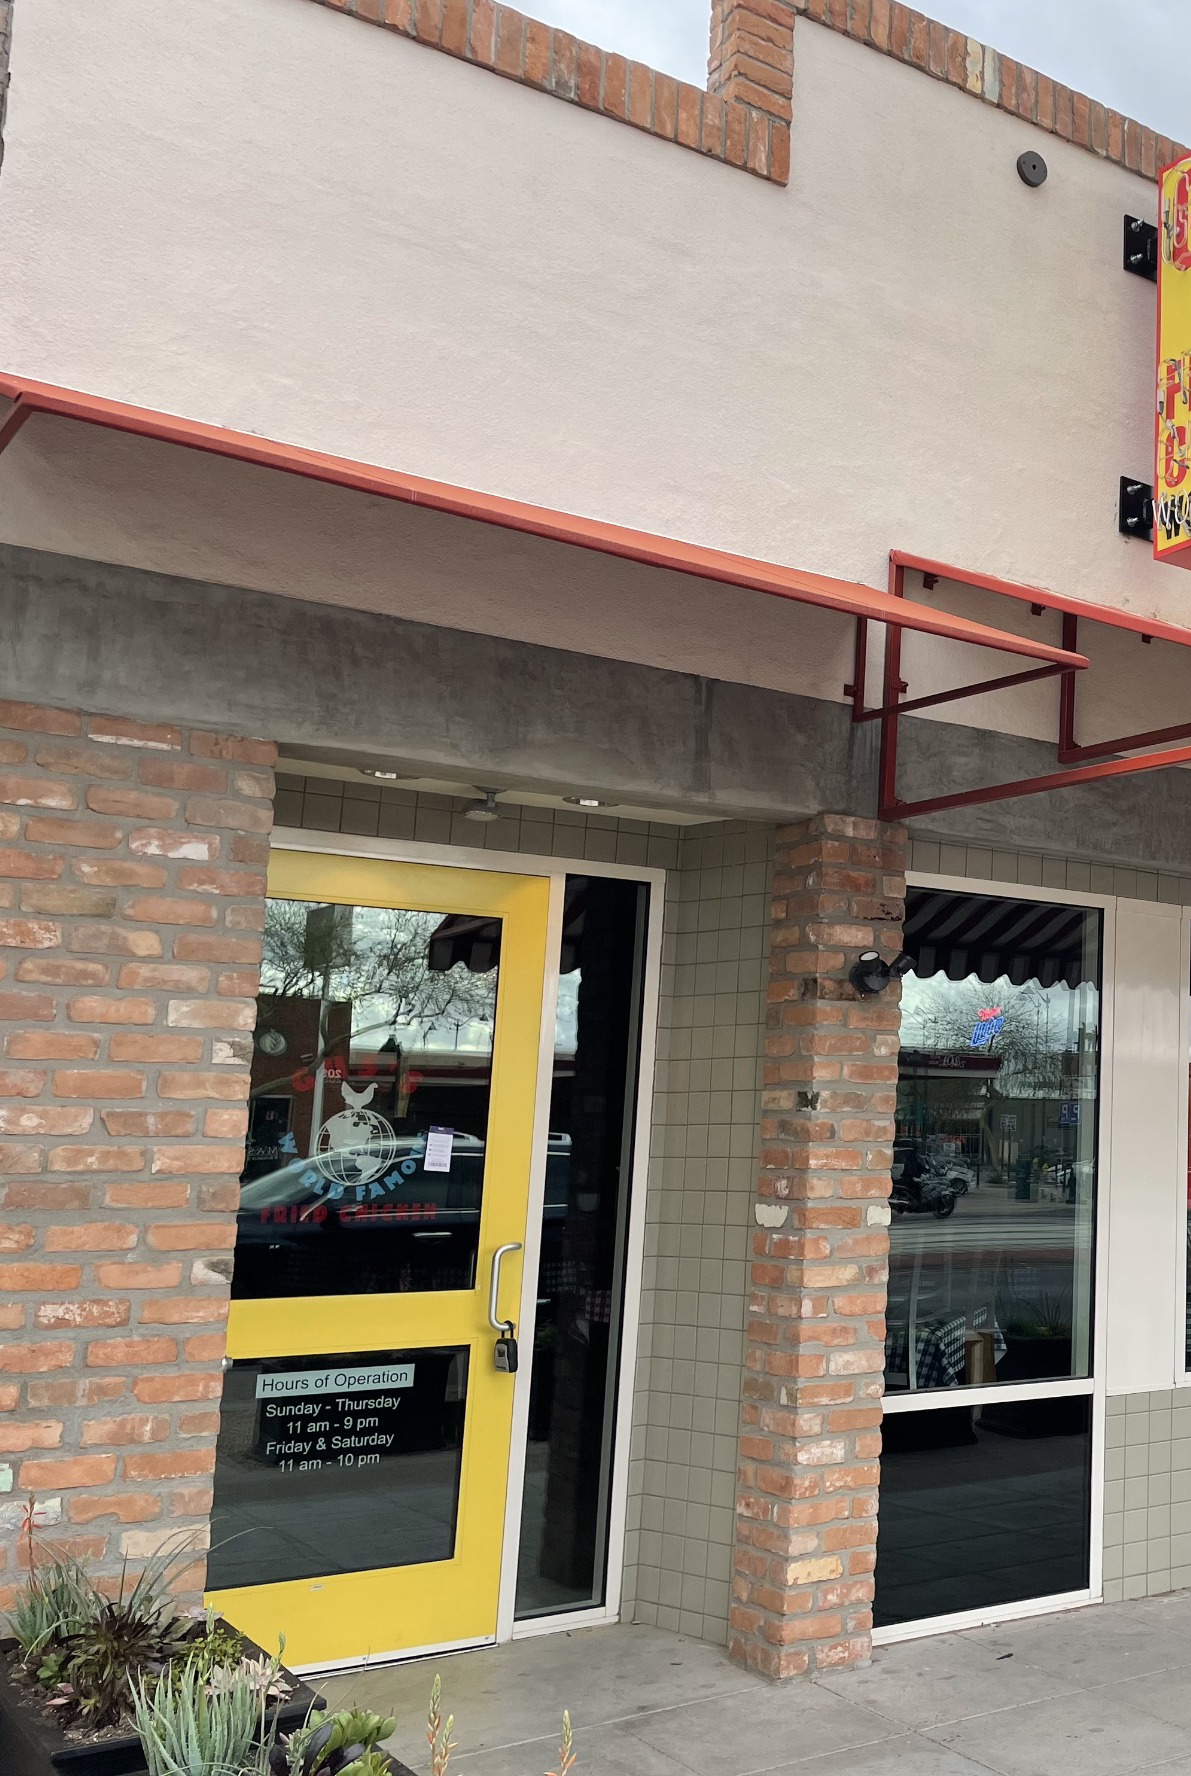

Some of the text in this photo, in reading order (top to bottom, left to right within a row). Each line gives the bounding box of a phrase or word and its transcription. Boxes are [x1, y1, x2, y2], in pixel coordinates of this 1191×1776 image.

[278, 1131, 345, 1200] WORLD
[260, 1203, 437, 1224] FRIED CHICKEN
[262, 1370, 408, 1392] Hours of Operation
[265, 1402, 322, 1417] Sunday
[336, 1396, 401, 1411] Thursday
[286, 1421, 301, 1434] 11
[307, 1420, 330, 1433] am
[343, 1416, 353, 1430] 9
[357, 1417, 379, 1431] pm
[266, 1433, 395, 1455] Friday & Saturday
[278, 1459, 293, 1472] 11
[299, 1459, 322, 1471] am
[337, 1453, 354, 1467] 10
[358, 1453, 380, 1467] pm
